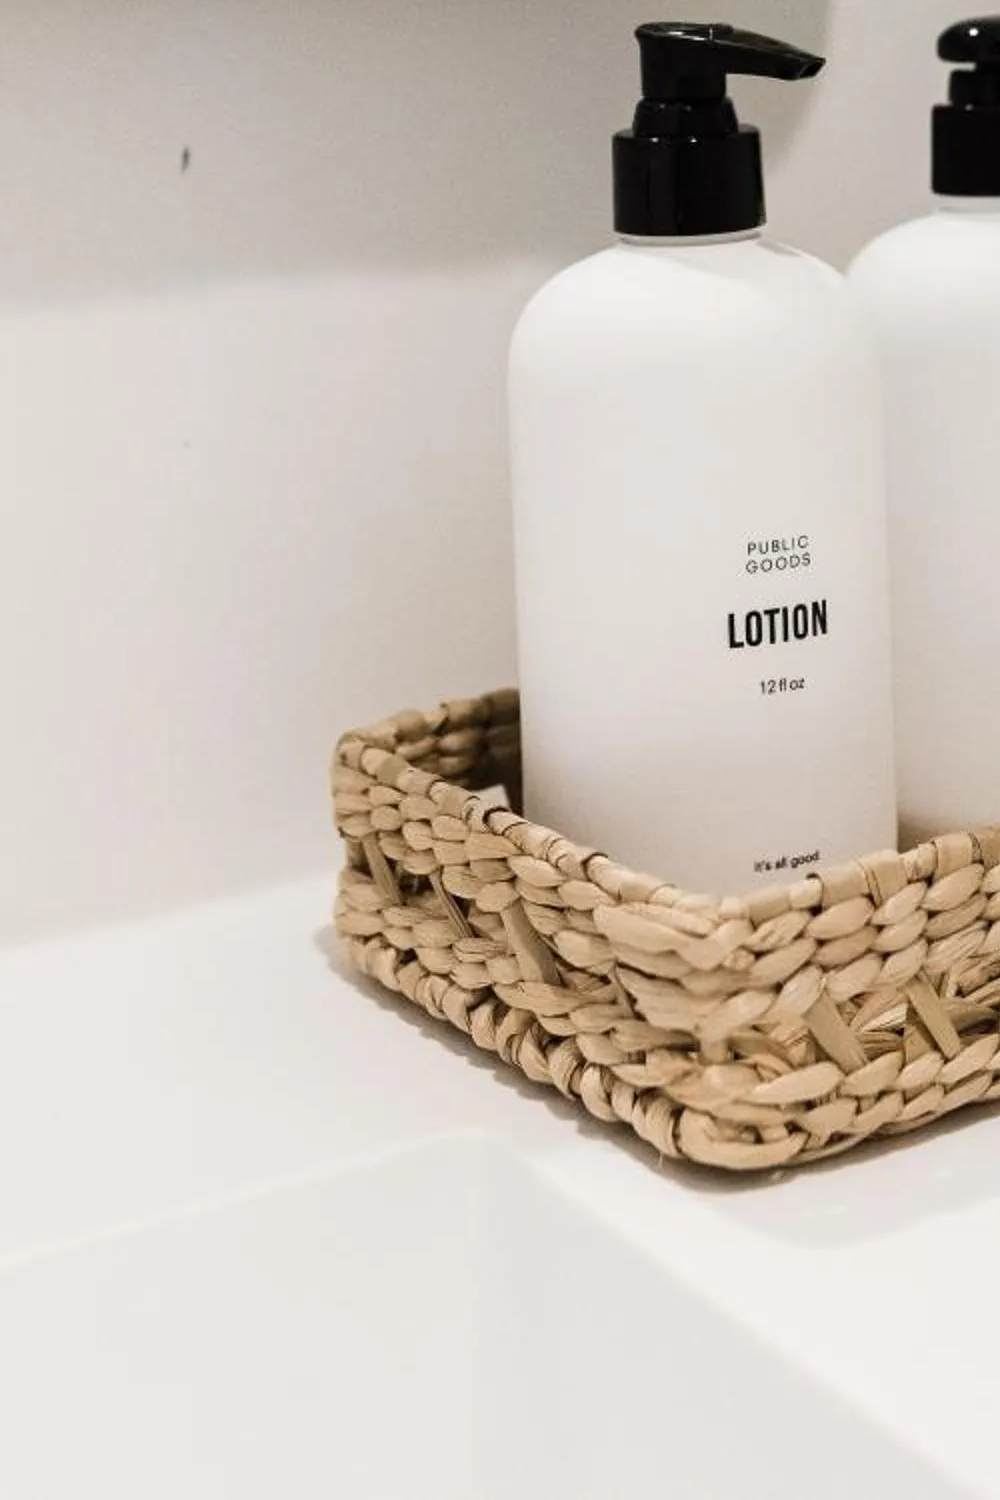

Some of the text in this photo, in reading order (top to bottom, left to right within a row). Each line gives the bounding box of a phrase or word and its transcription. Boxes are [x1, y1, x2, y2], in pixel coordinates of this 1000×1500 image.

[747, 535, 809, 556] PUBLIC
[745, 552, 811, 574] GOODS
[727, 598, 828, 649] LOTION
[760, 679, 777, 694] 12
